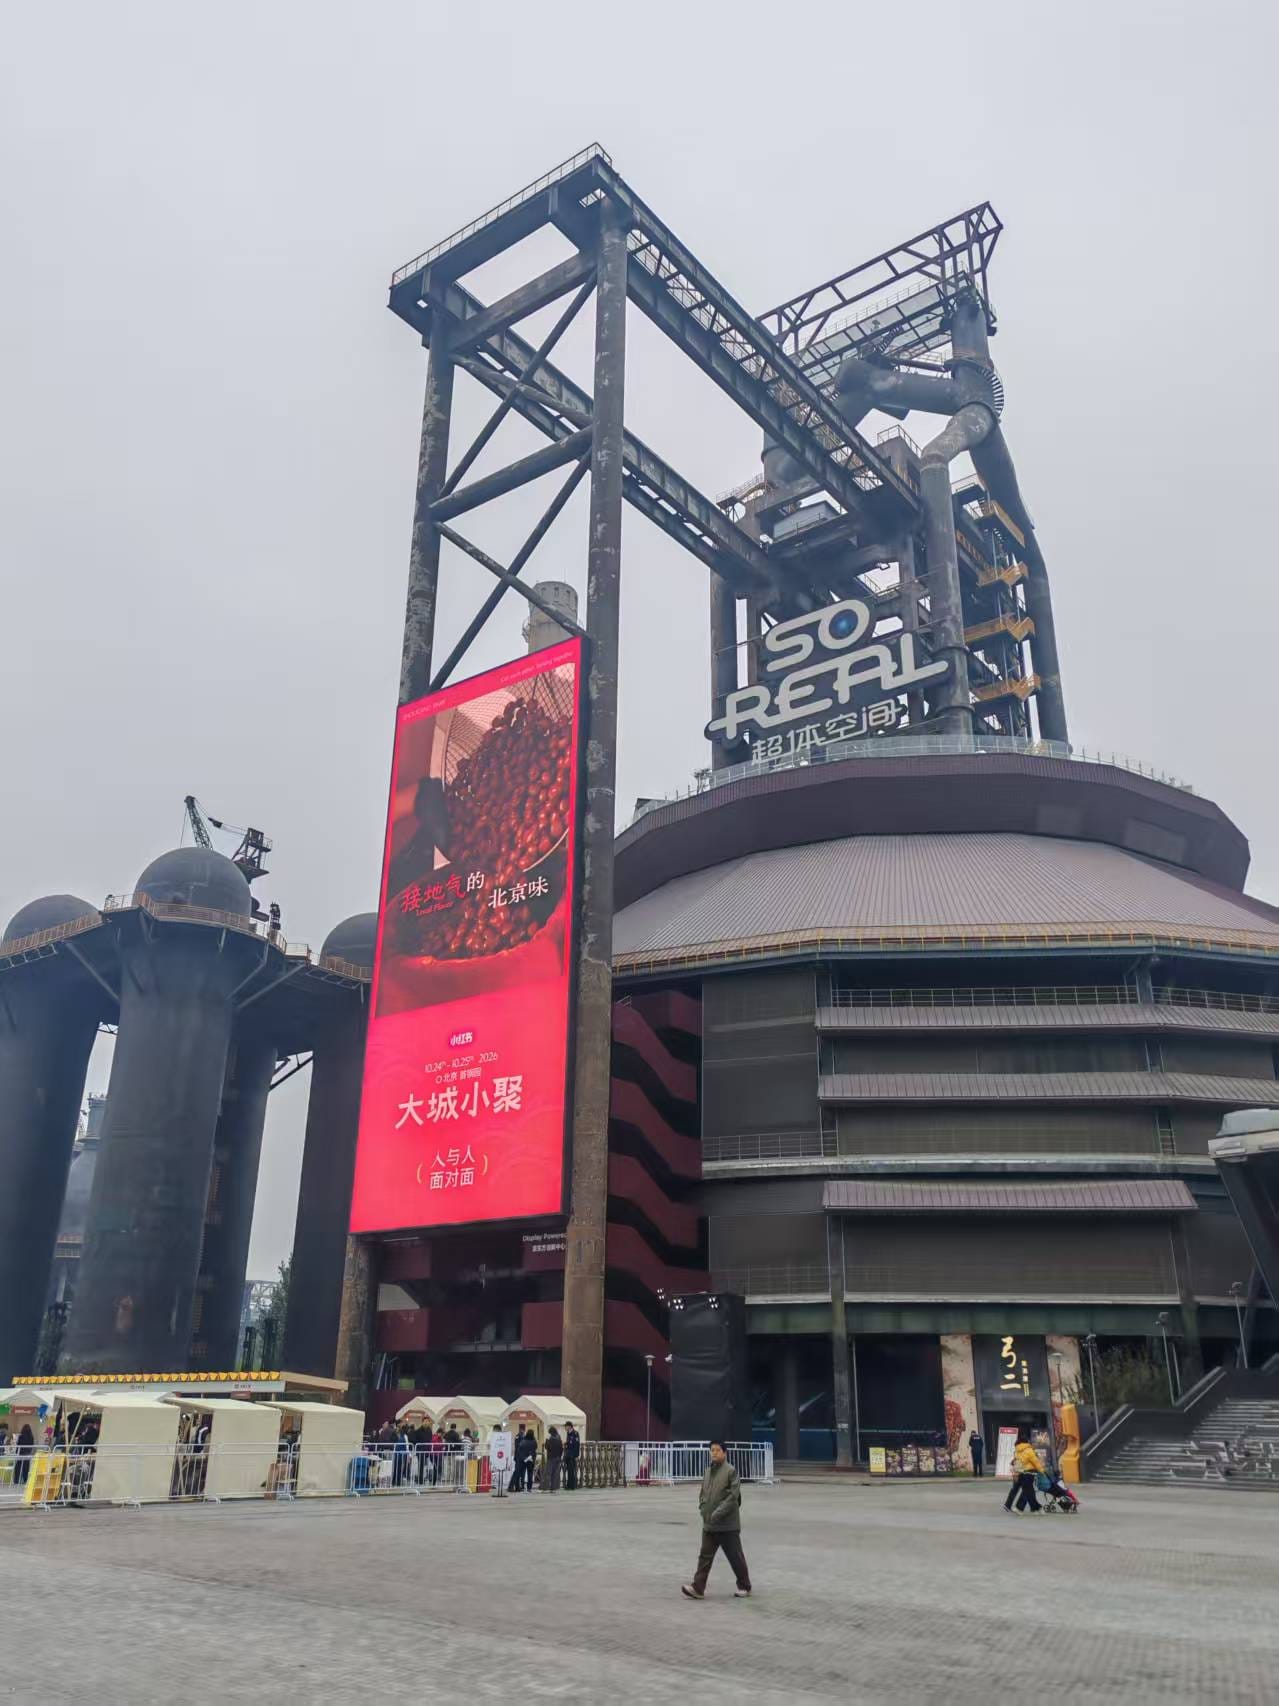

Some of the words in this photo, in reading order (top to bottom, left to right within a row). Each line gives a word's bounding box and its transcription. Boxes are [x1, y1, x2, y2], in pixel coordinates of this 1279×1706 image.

[765, 599, 870, 672] SO
[707, 632, 949, 740] REAL
[750, 698, 907, 766] 超体空间
[401, 870, 485, 912] 接地气的
[488, 876, 549, 909] 北京味
[450, 1031, 473, 1046] 小红书
[395, 1074, 523, 1129] 大城小聚
[429, 1167, 475, 1190] 面对面
[430, 1145, 476, 1168] 人与人
